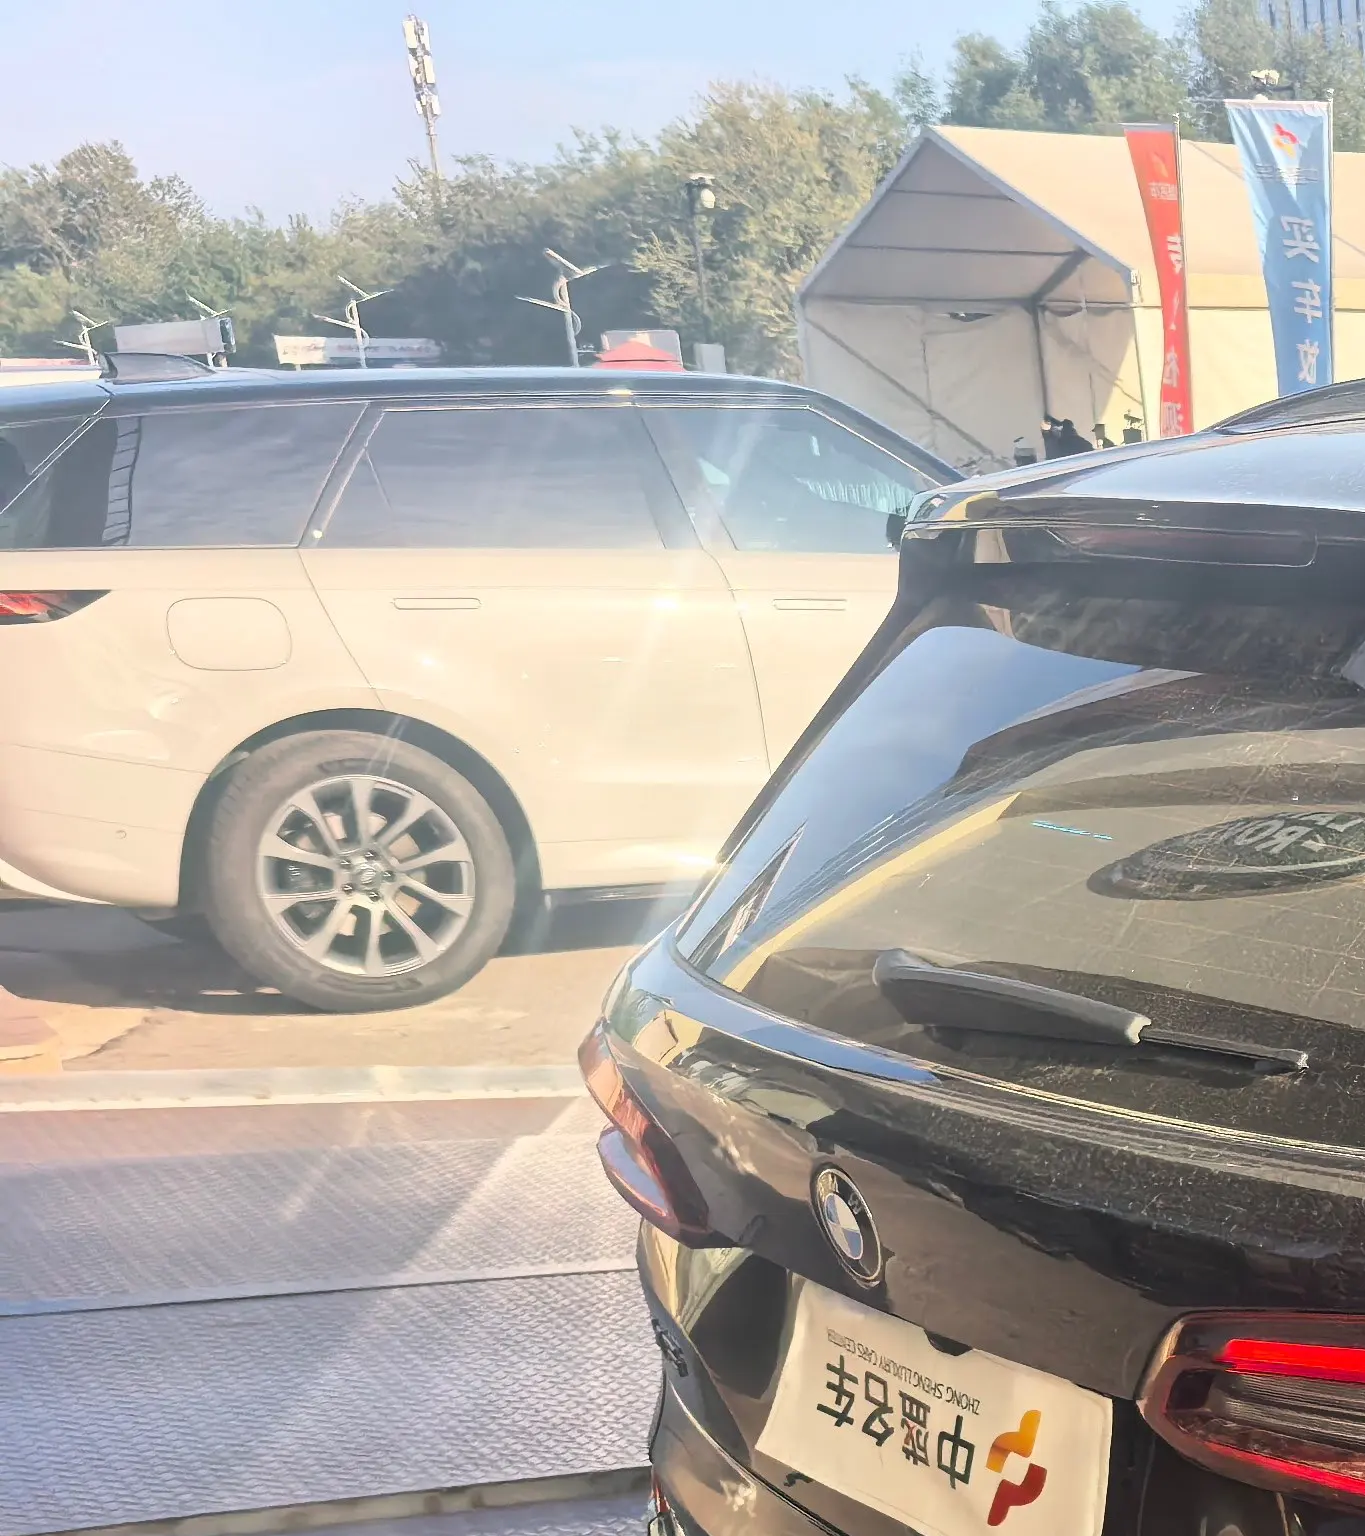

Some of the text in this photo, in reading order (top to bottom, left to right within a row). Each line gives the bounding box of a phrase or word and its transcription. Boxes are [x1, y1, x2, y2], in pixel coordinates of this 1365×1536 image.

[912, 1368, 945, 1400] SHENG
[945, 1386, 982, 1416] ZHONG
[816, 1354, 976, 1490] 中盛名车
